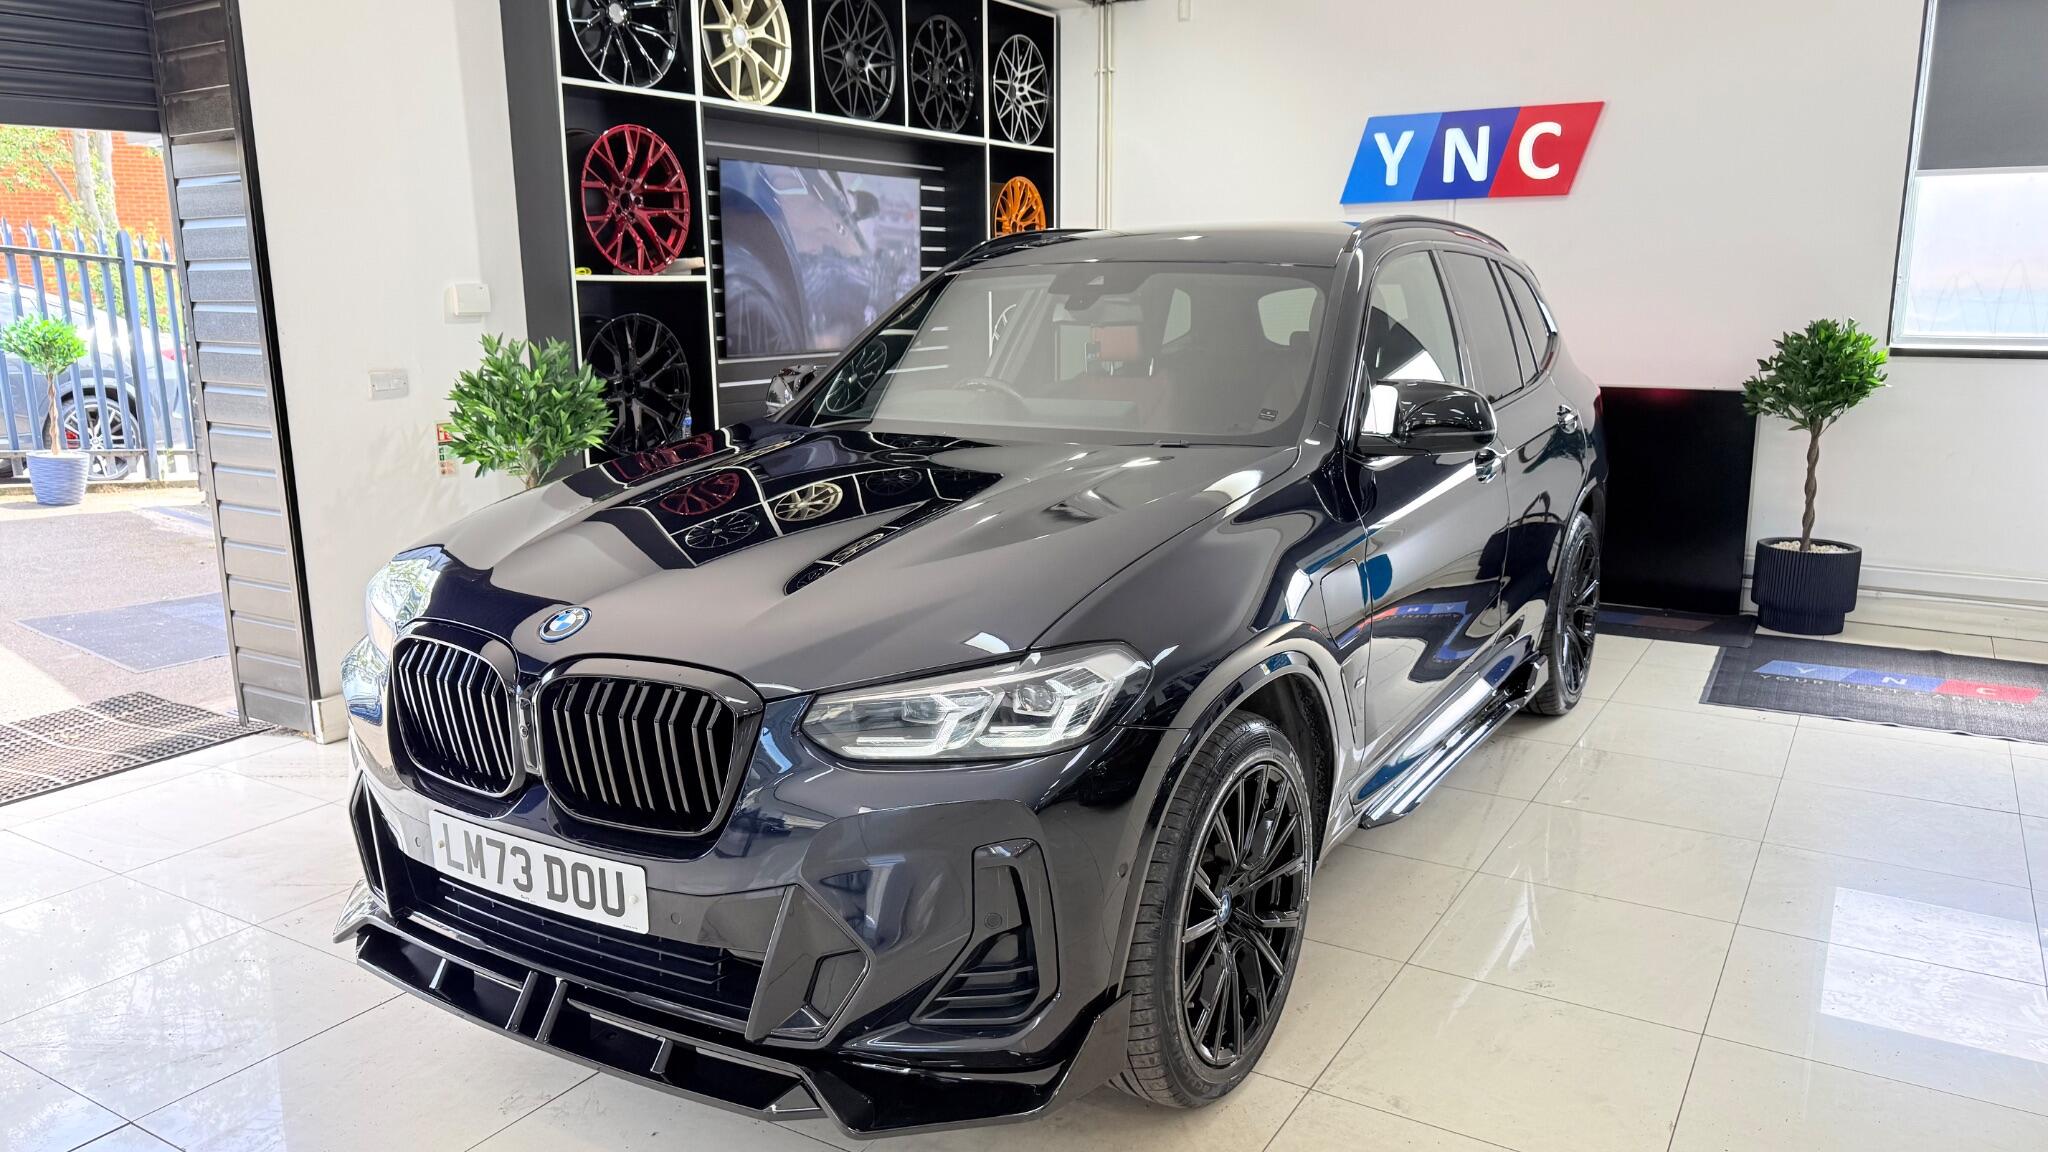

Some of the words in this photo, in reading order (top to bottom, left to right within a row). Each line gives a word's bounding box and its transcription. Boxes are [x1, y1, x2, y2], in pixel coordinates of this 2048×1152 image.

[1374, 121, 1562, 186] YNC
[1760, 674, 1824, 685] YOUR
[1838, 682, 1898, 694] NEXT
[1914, 690, 1963, 702] CAR
[1794, 666, 1997, 696] YNC
[443, 823, 533, 893] LM73
[544, 854, 625, 918] DOU
